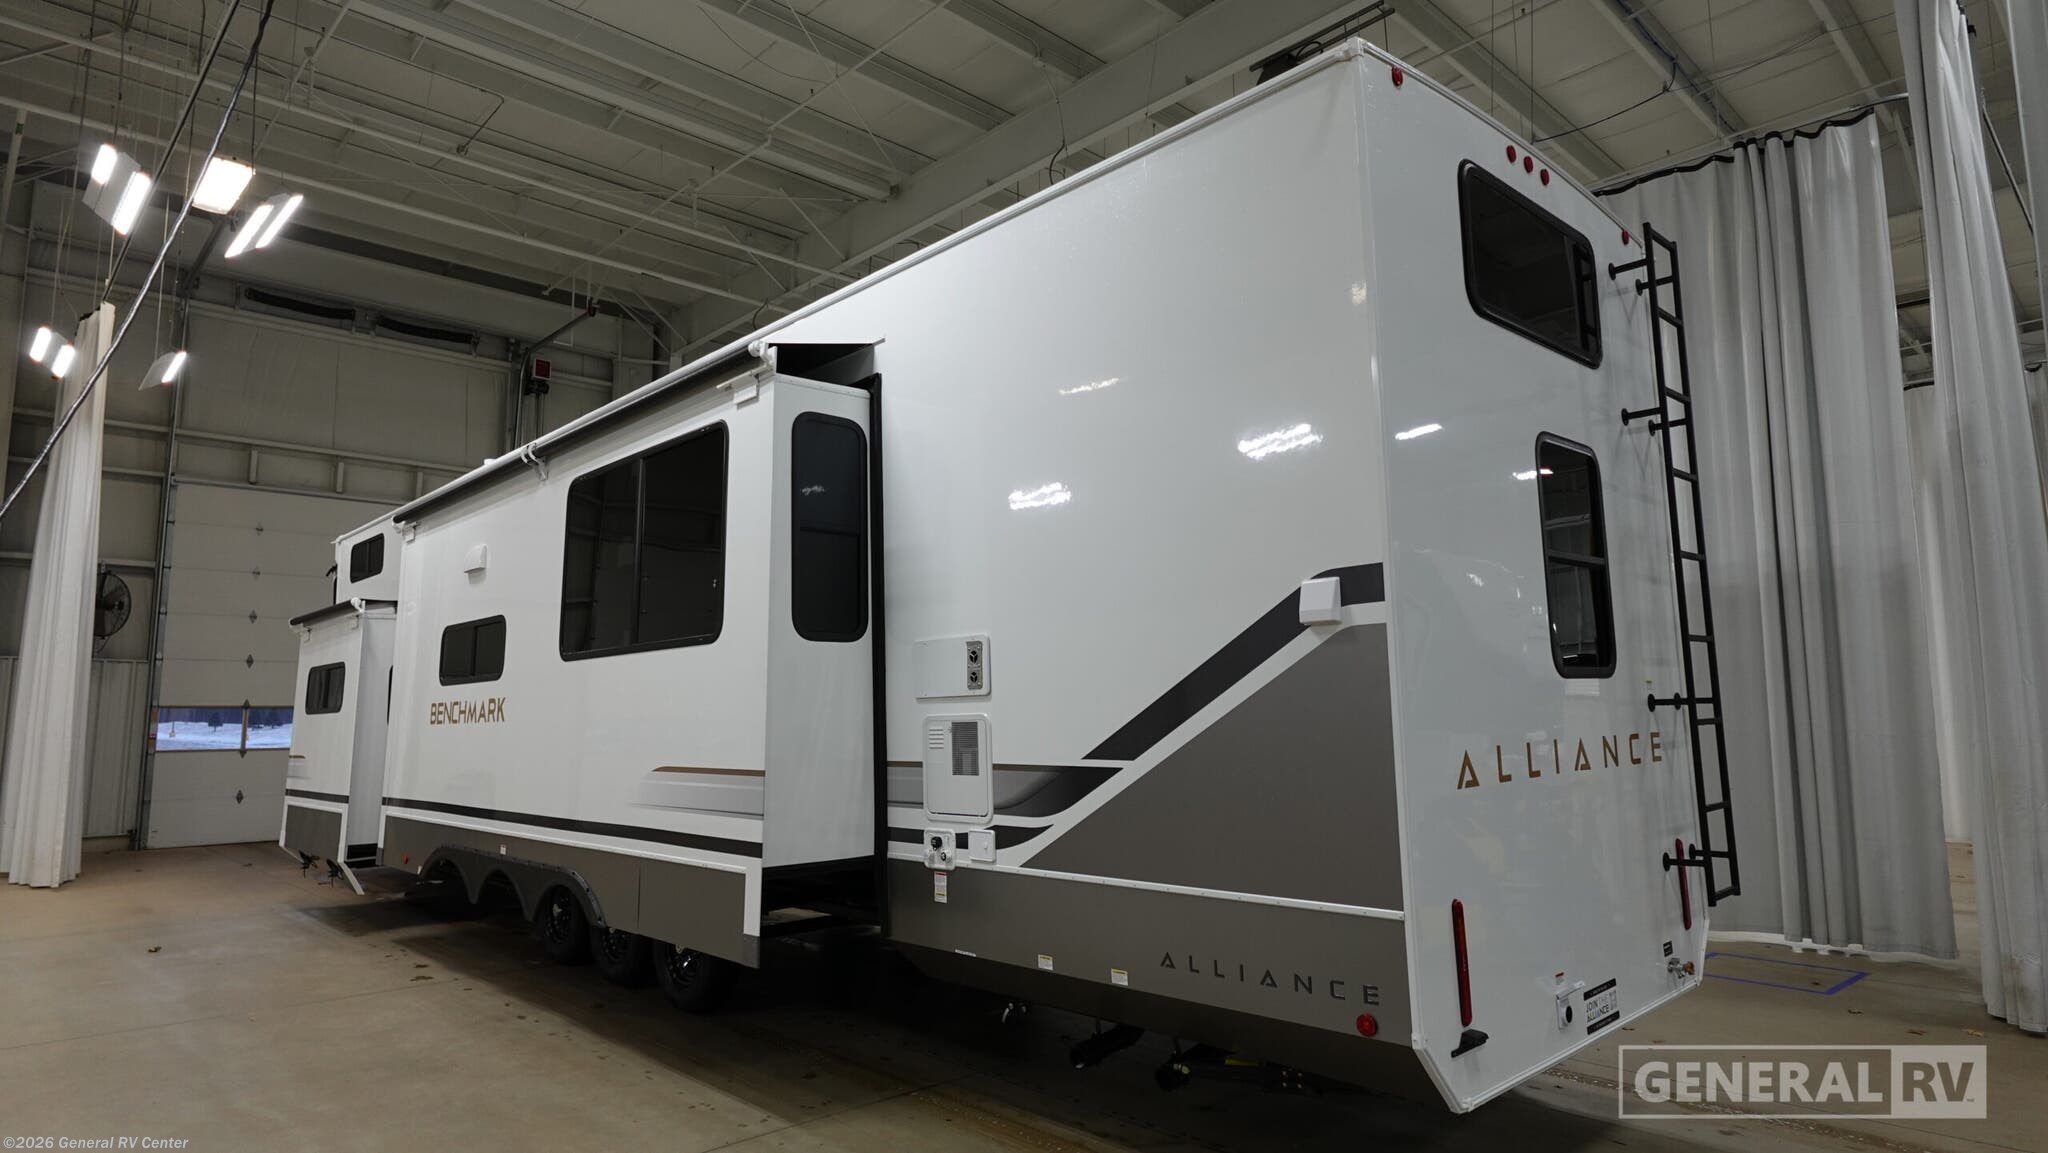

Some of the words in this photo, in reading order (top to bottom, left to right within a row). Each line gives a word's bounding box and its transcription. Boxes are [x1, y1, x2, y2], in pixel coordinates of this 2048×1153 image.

[430, 697, 506, 725] BENCHMARK
[1457, 732, 1663, 790] ALLIANCE
[1160, 951, 1380, 1006] ALLIANCE
